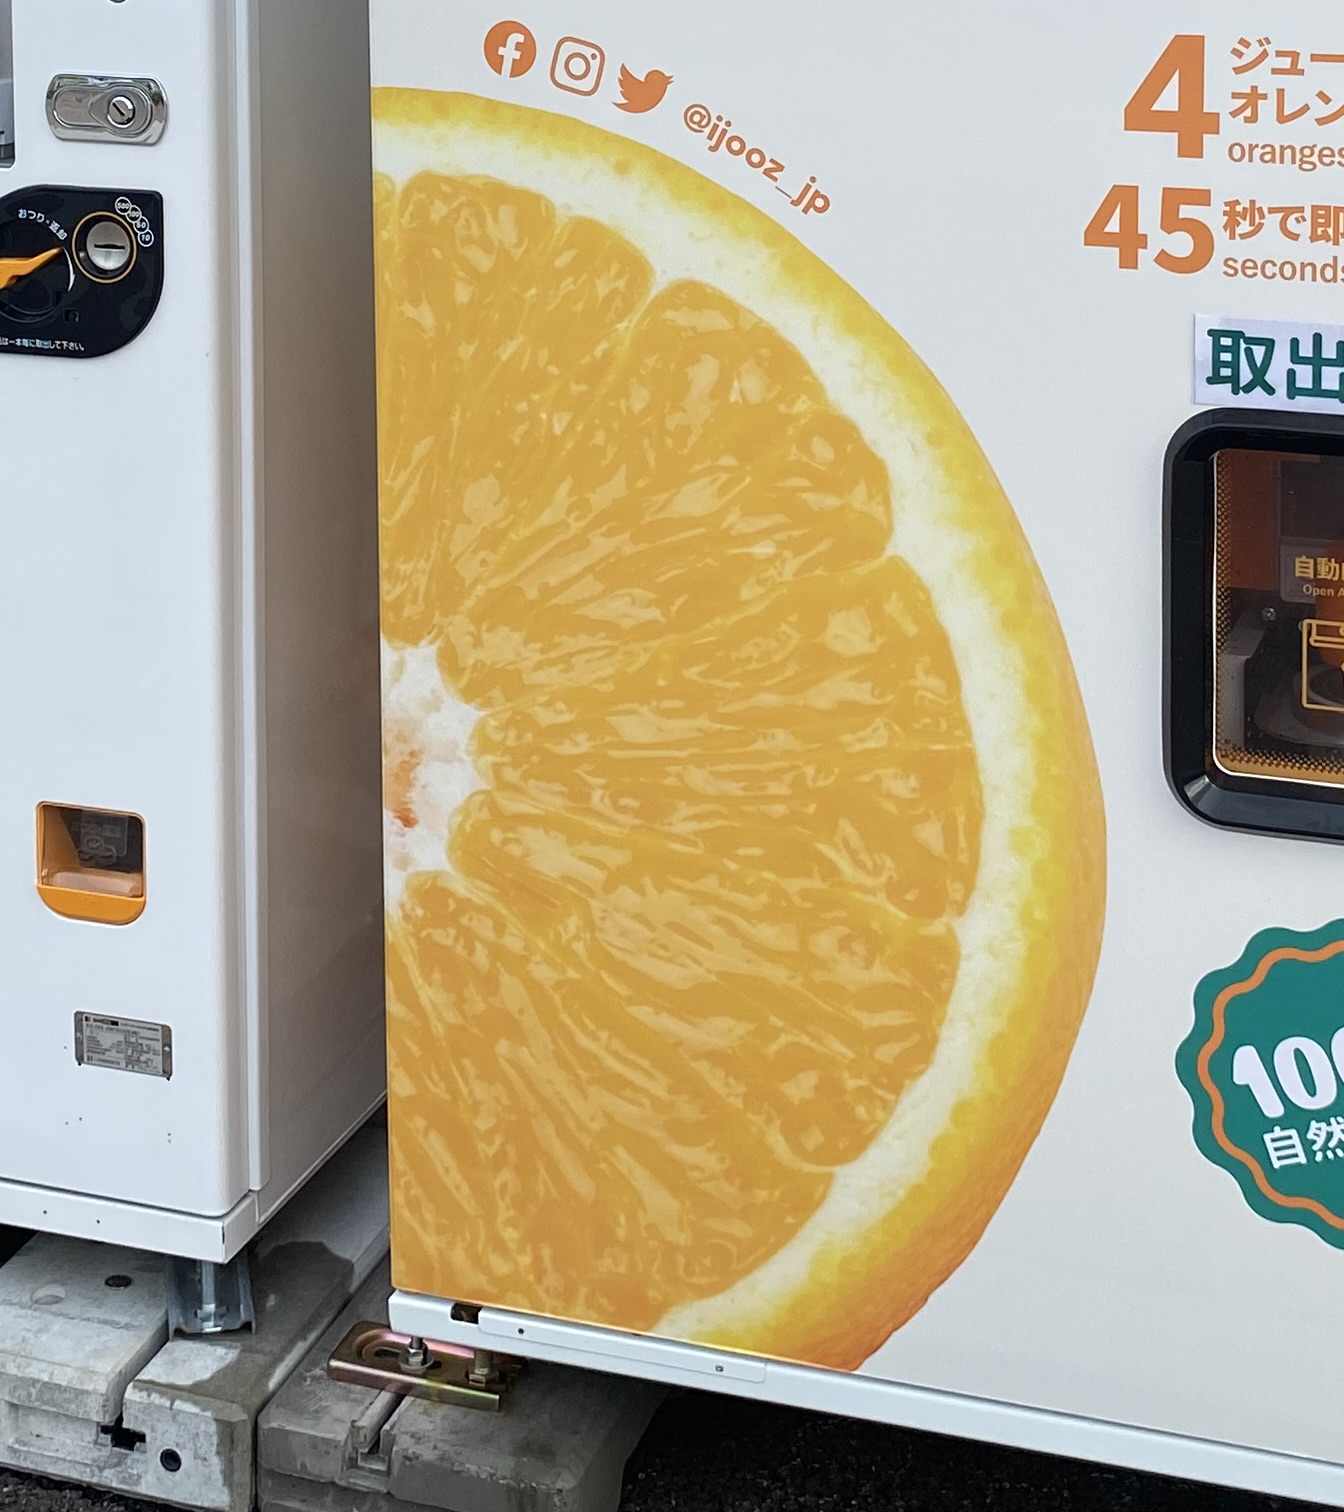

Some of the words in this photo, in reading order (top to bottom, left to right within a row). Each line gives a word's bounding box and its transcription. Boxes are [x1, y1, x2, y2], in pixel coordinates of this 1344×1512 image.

[1123, 34, 1220, 159] 4
[683, 103, 831, 215] @ijooz_jp
[1083, 184, 1216, 275] 45
[1302, 584, 1335, 599] Open
